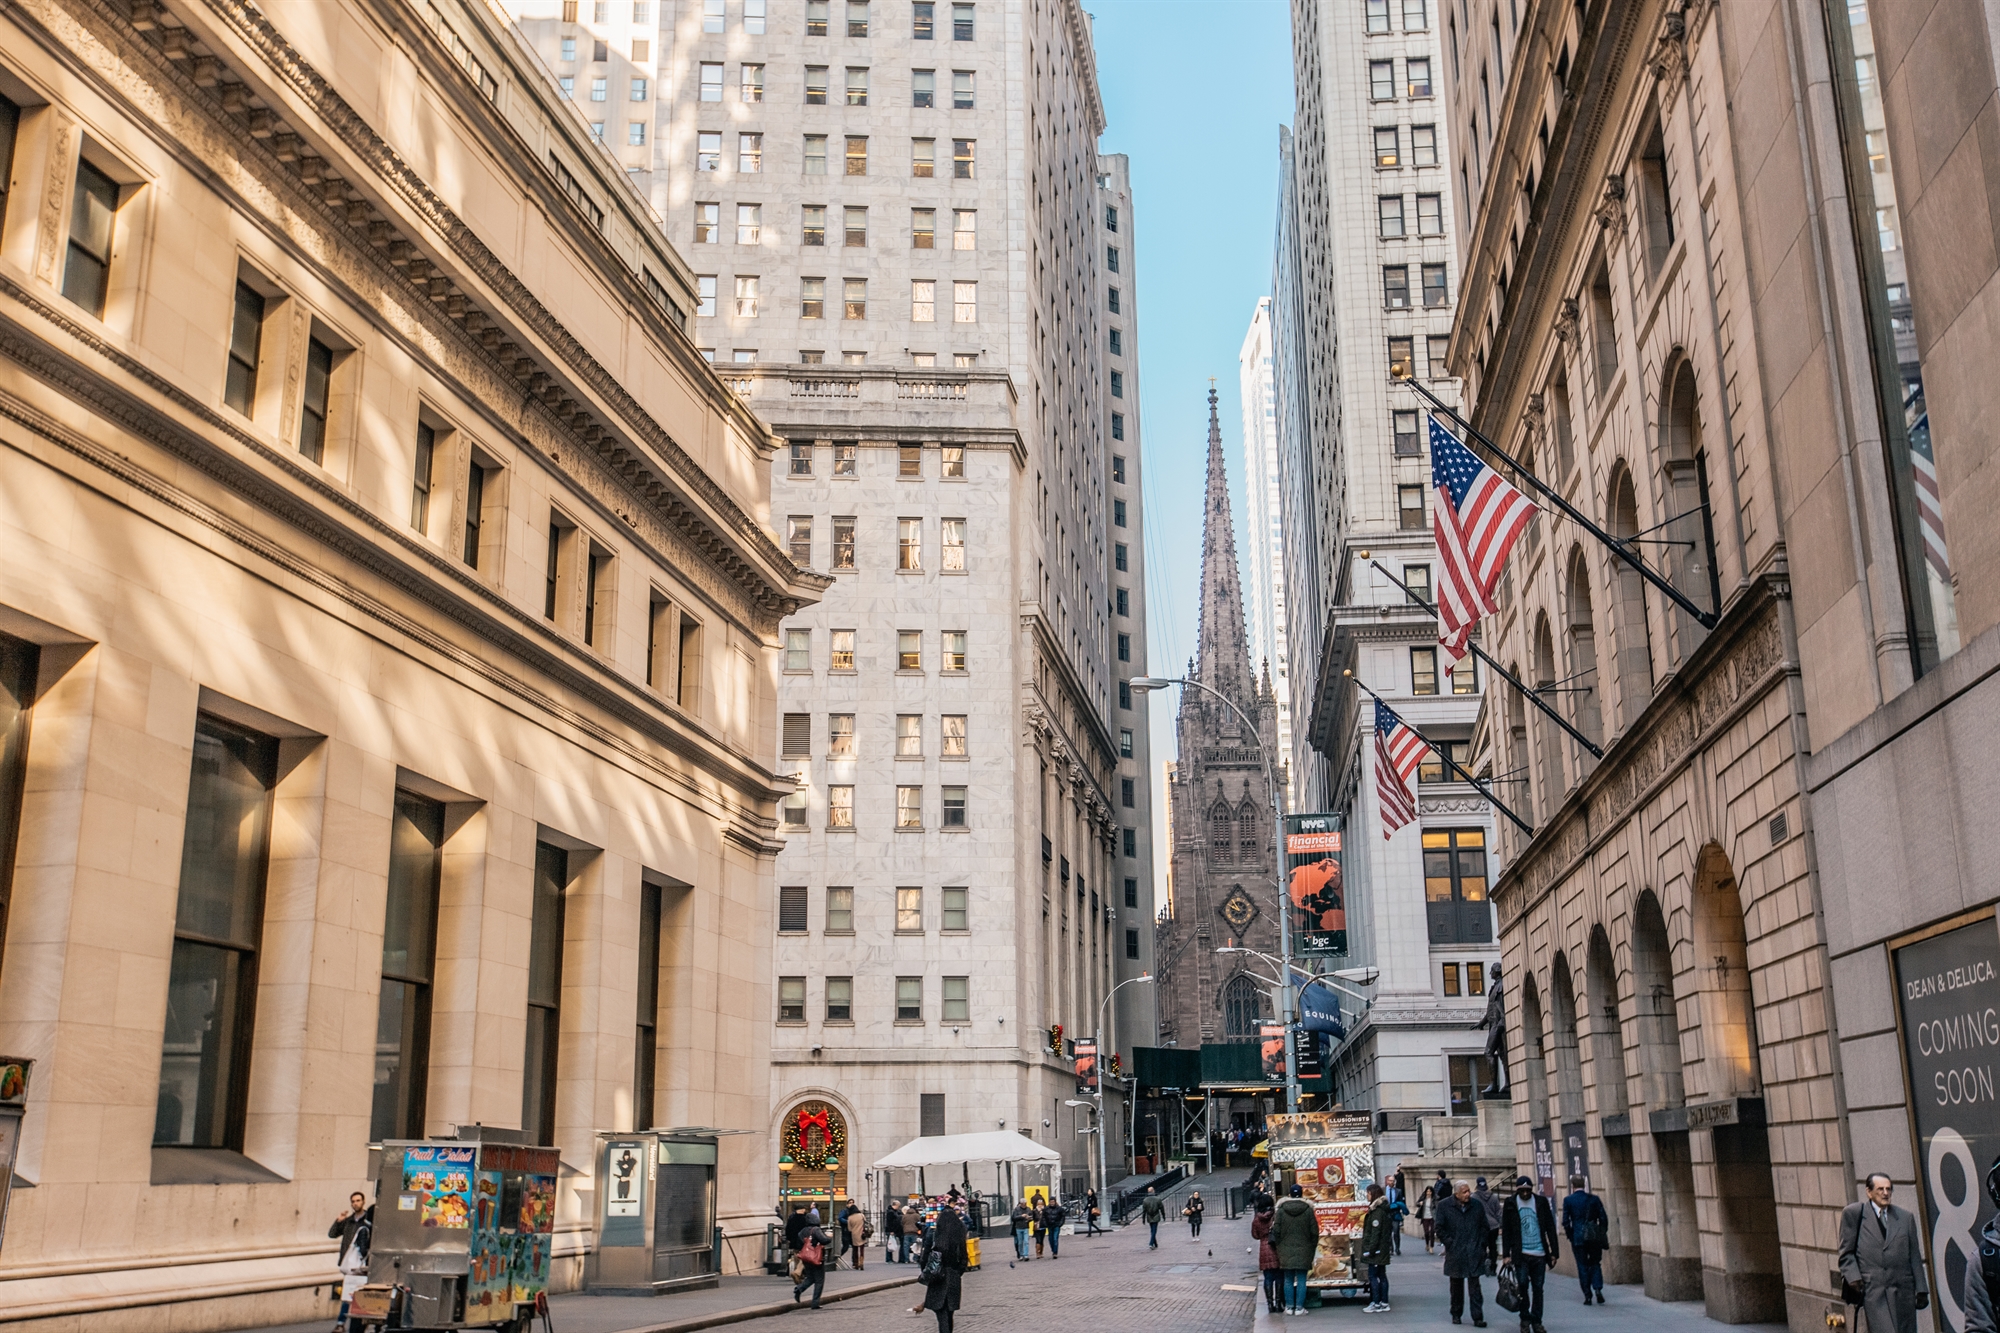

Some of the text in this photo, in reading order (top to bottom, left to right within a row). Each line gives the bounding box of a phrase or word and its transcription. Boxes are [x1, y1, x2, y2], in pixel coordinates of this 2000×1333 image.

[1302, 820, 1325, 829] NYC
[1288, 834, 1339, 848] financial
[1312, 936, 1329, 947] bgc
[1907, 960, 1994, 1000] DEAN & DELUCA
[1918, 1008, 2000, 1056] COMING
[1935, 1065, 1994, 1106] SOON
[406, 1147, 434, 1161] Fruit
[437, 1147, 474, 1163] Salad
